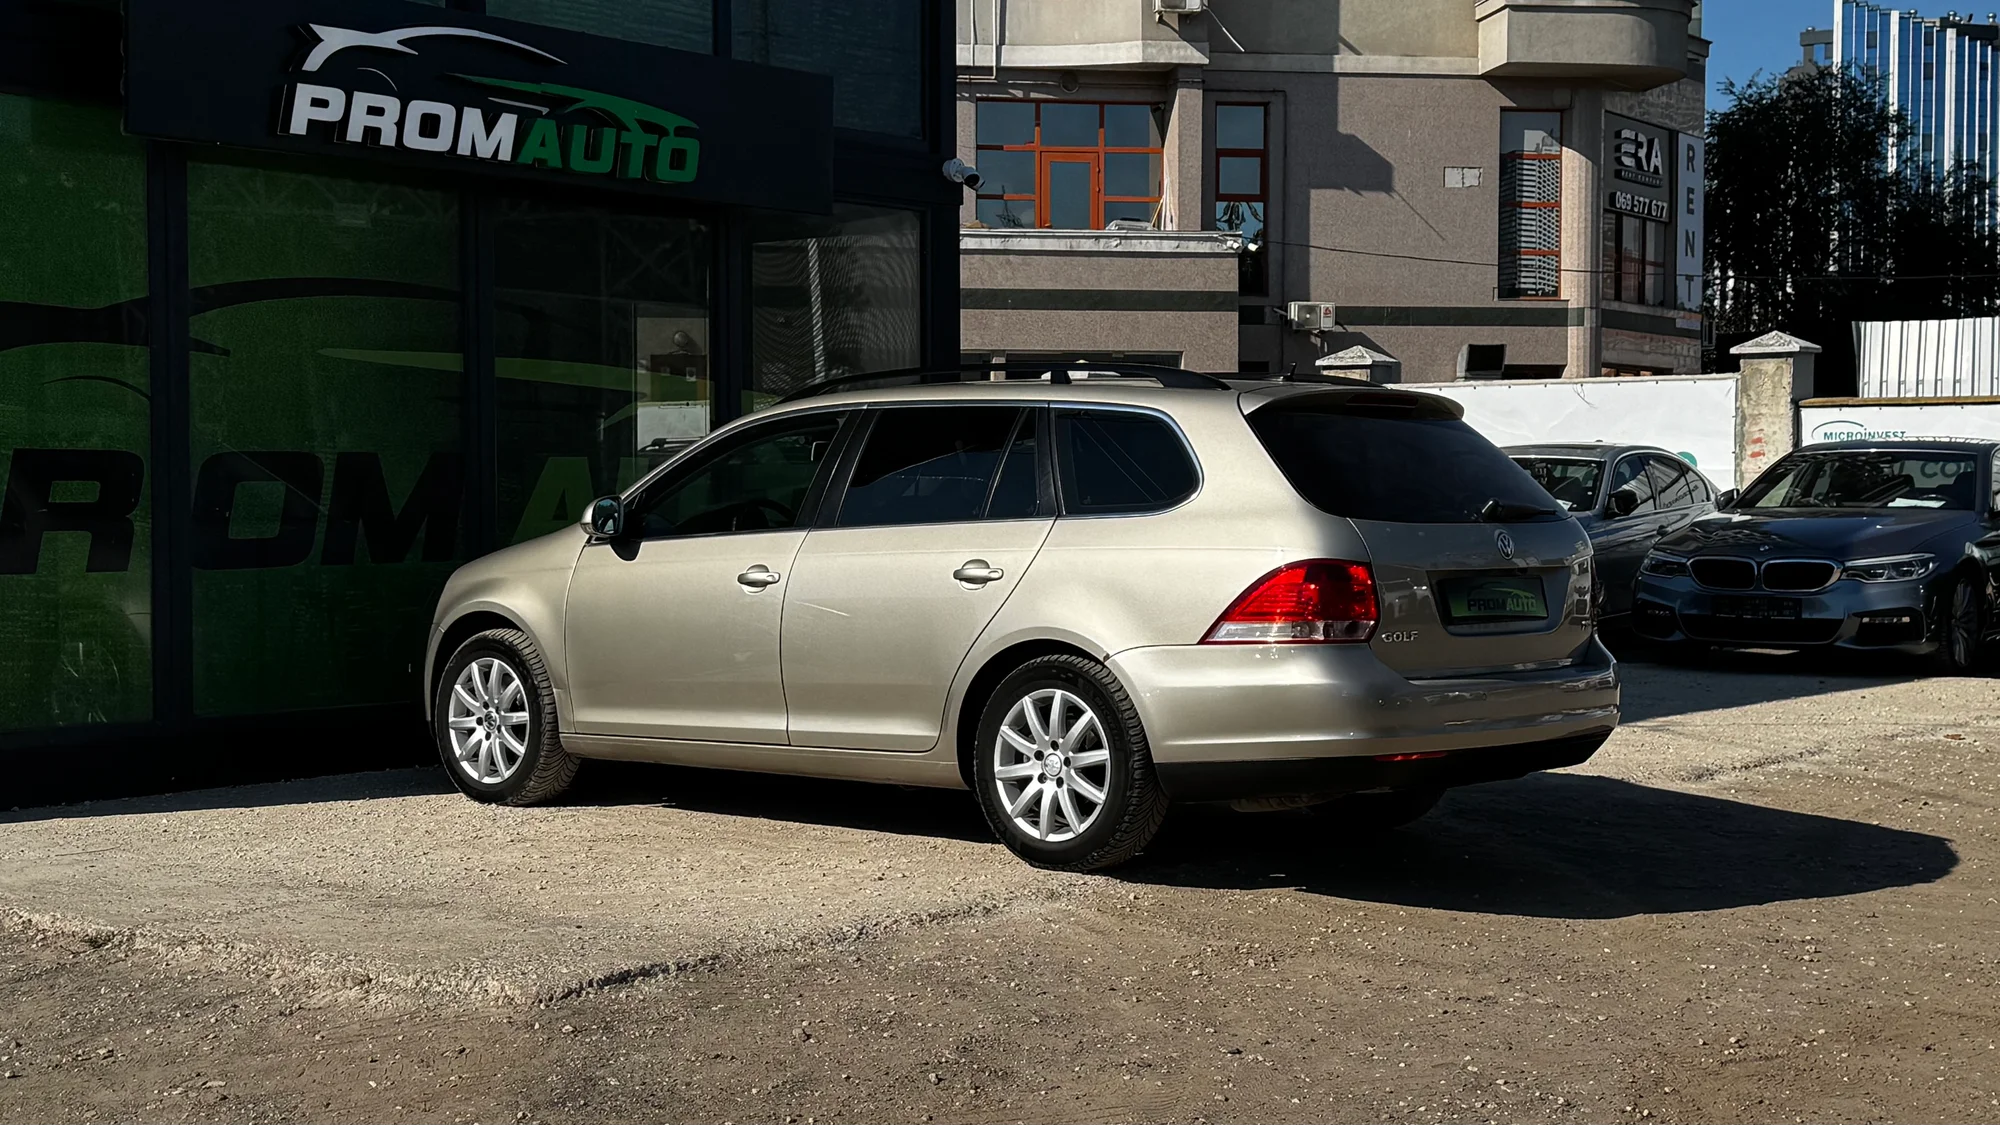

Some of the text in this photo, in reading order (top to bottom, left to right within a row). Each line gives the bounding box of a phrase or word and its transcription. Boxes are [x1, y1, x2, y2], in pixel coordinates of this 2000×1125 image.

[289, 82, 700, 183] PROMAUTO
[1619, 128, 1663, 175] ERA
[1615, 191, 1668, 218] 069 577 677
[1685, 143, 1696, 302] RENT
[1467, 597, 1537, 612] PROMAUTO
[1381, 631, 1419, 643] GOLF
